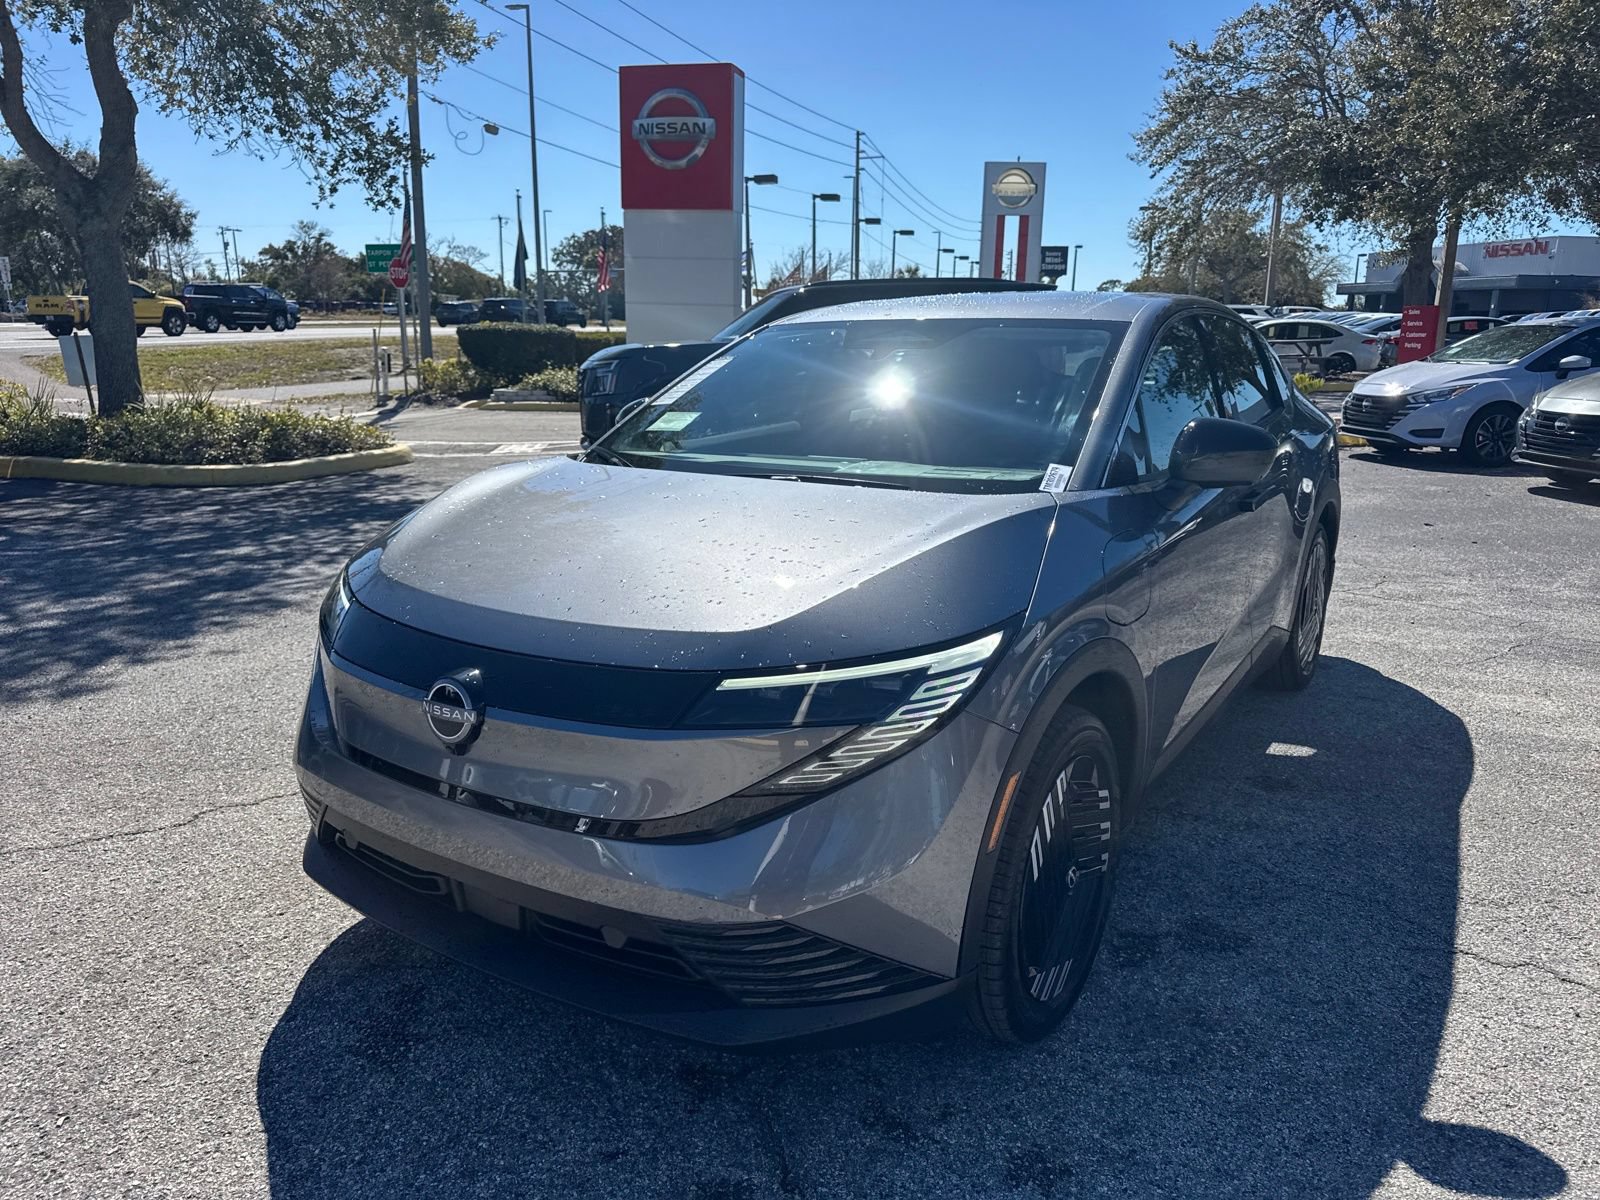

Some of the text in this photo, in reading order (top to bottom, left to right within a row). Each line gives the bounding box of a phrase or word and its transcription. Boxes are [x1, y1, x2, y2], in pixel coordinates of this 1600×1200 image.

[639, 122, 706, 135] NISSAN
[1483, 240, 1549, 258] NISSAN
[390, 267, 408, 279] STOP
[423, 700, 475, 721] NISSAN
